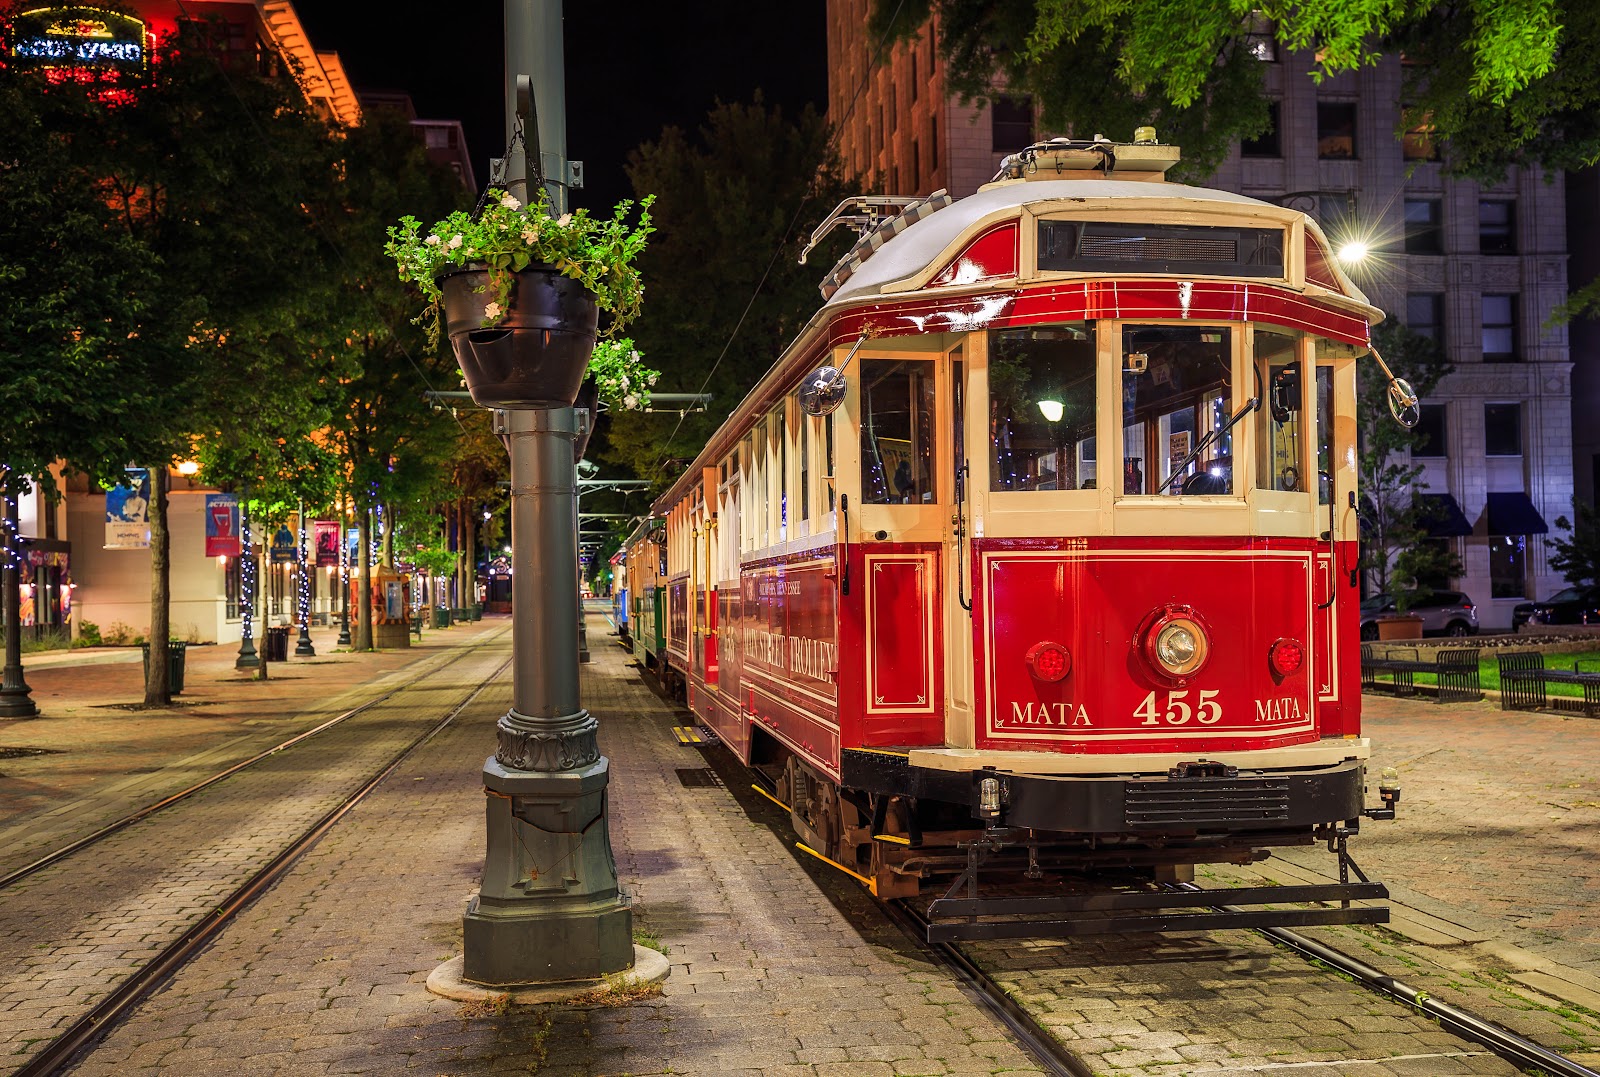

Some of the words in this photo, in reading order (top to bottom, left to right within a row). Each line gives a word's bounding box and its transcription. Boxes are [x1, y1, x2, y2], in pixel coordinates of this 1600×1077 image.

[207, 500, 238, 508] ACTION
[777, 580, 801, 596] TENNESSEE
[744, 627, 758, 659] MAIN
[760, 631, 786, 668] STREET
[789, 635, 834, 685] TROLLEY
[1011, 701, 1094, 727] MATA
[1132, 688, 1223, 726] 455
[1254, 697, 1302, 723] MATA
